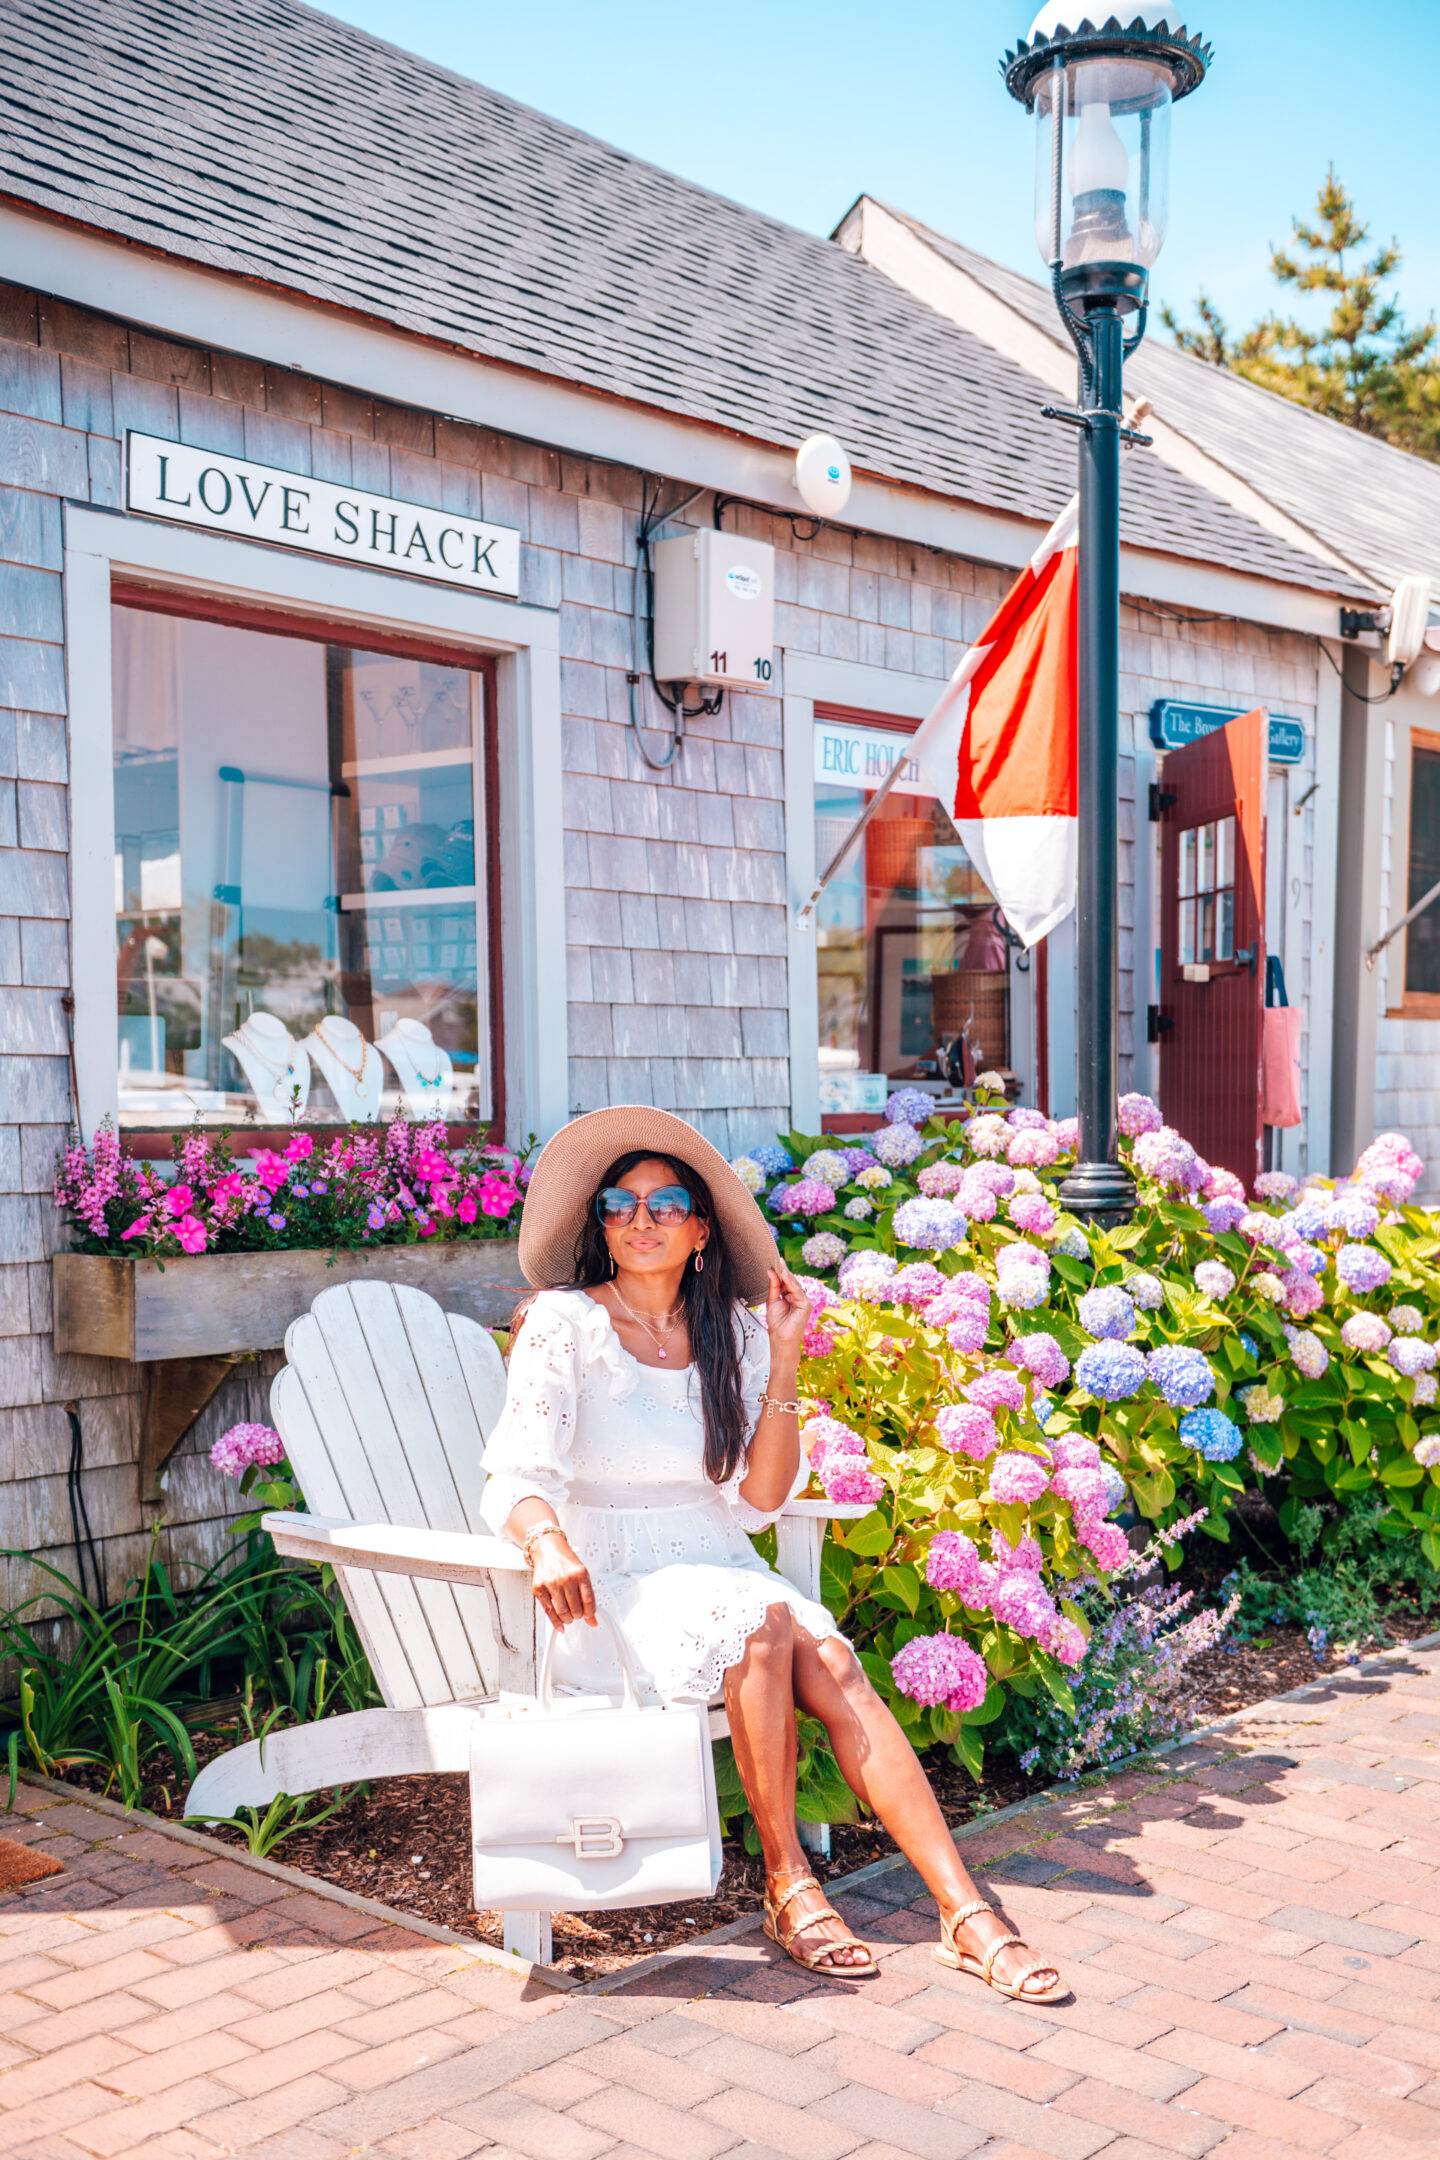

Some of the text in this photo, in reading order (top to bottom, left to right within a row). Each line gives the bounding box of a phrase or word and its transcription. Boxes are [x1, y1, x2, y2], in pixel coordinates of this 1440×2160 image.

[155, 454, 500, 579] LOVE SHACK
[710, 650, 727, 673] 11
[753, 657, 772, 681] 10
[1169, 711, 1191, 734] The
[822, 736, 861, 775] ERIC
[572, 1816, 624, 1859] B
